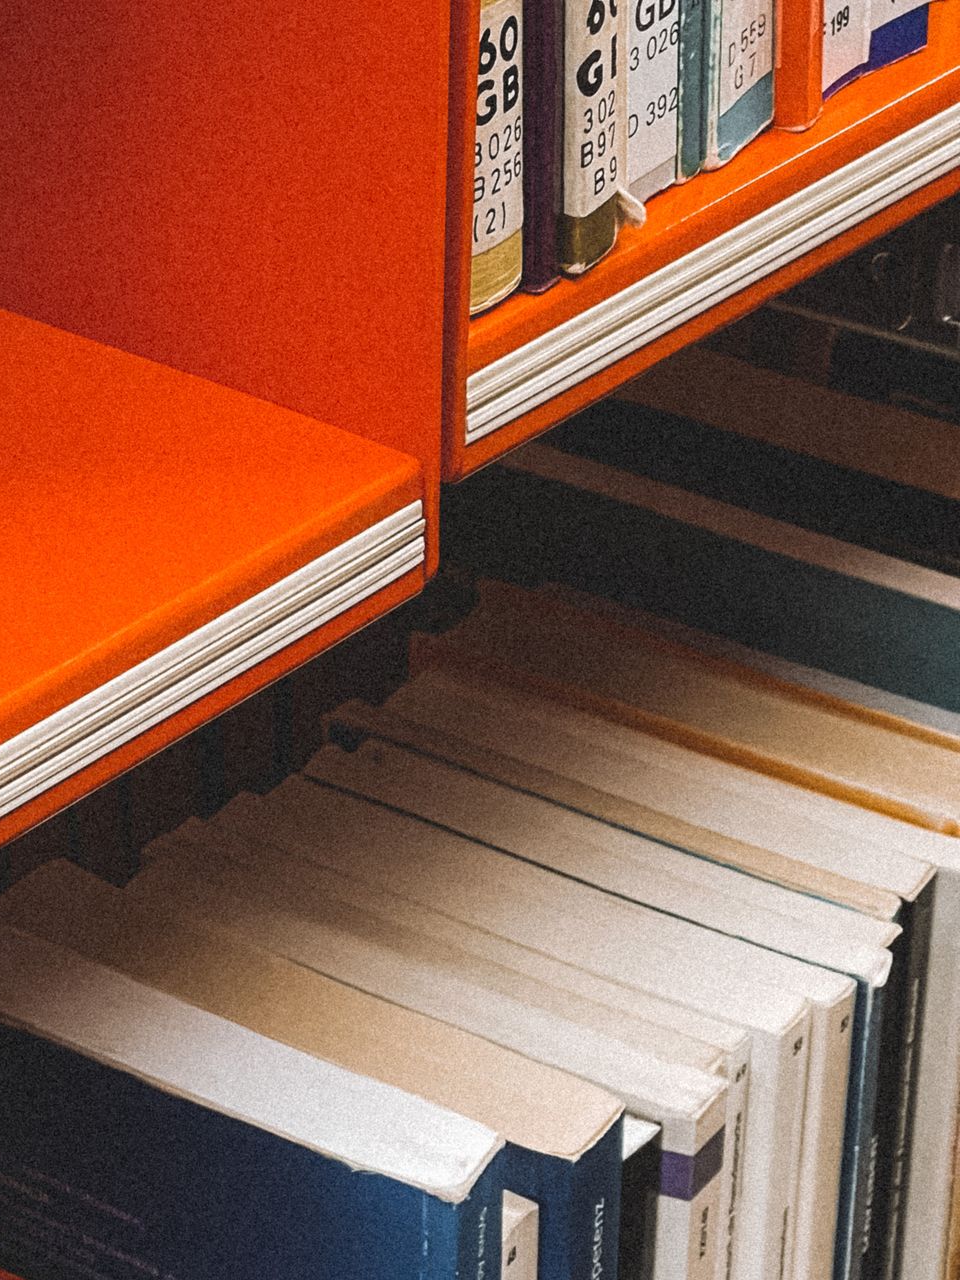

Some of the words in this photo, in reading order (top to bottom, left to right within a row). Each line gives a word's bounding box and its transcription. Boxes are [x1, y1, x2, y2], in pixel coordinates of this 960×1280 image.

[478, 15, 519, 76] 60
[646, 21, 680, 61] 026
[476, 64, 520, 127] GB
[646, 87, 679, 127] 392
[488, 116, 522, 161] 026
[491, 152, 522, 196] 256
